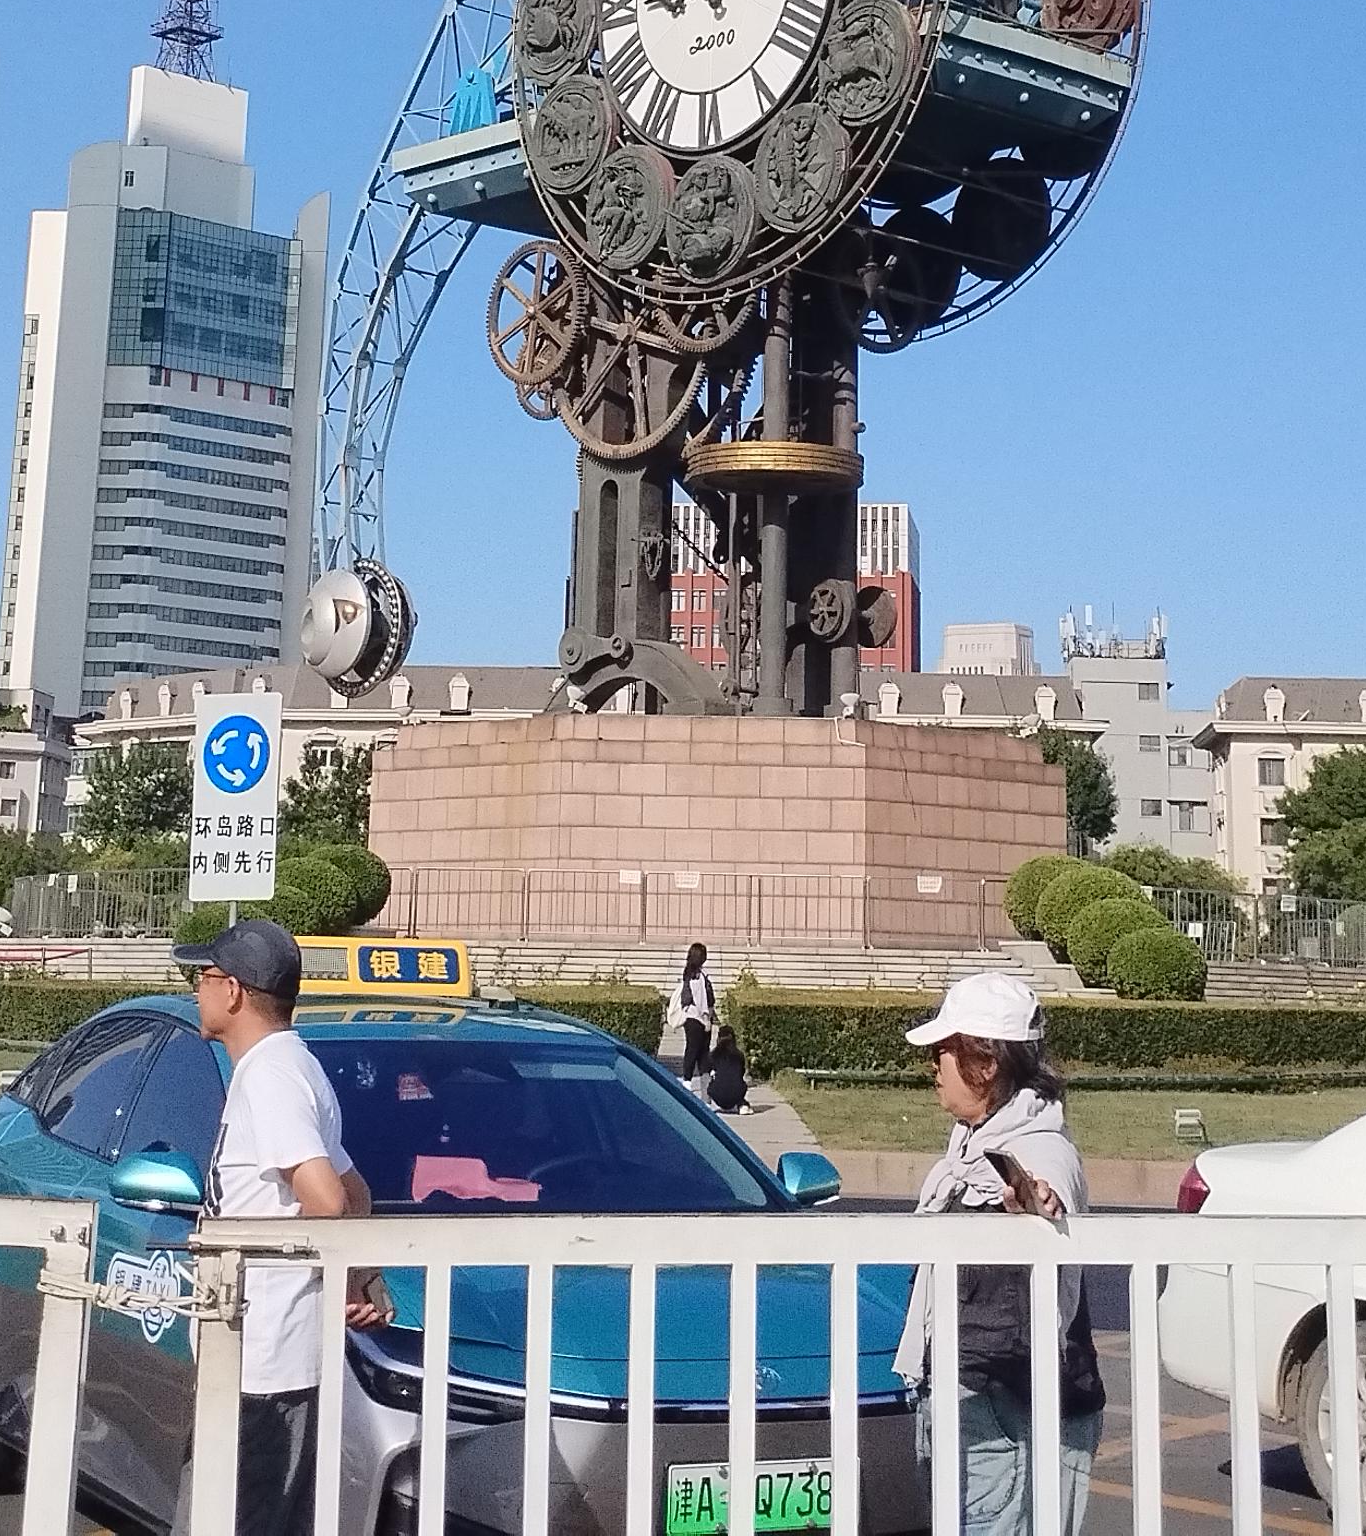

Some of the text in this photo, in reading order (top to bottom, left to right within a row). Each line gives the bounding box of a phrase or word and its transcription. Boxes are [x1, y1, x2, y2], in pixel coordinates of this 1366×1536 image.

[689, 28, 735, 55] 2000
[194, 814, 275, 839] 环岛路口
[192, 850, 274, 875] 内侧先行
[369, 949, 448, 980] 银建
[754, 1471, 832, 1519] Q738
